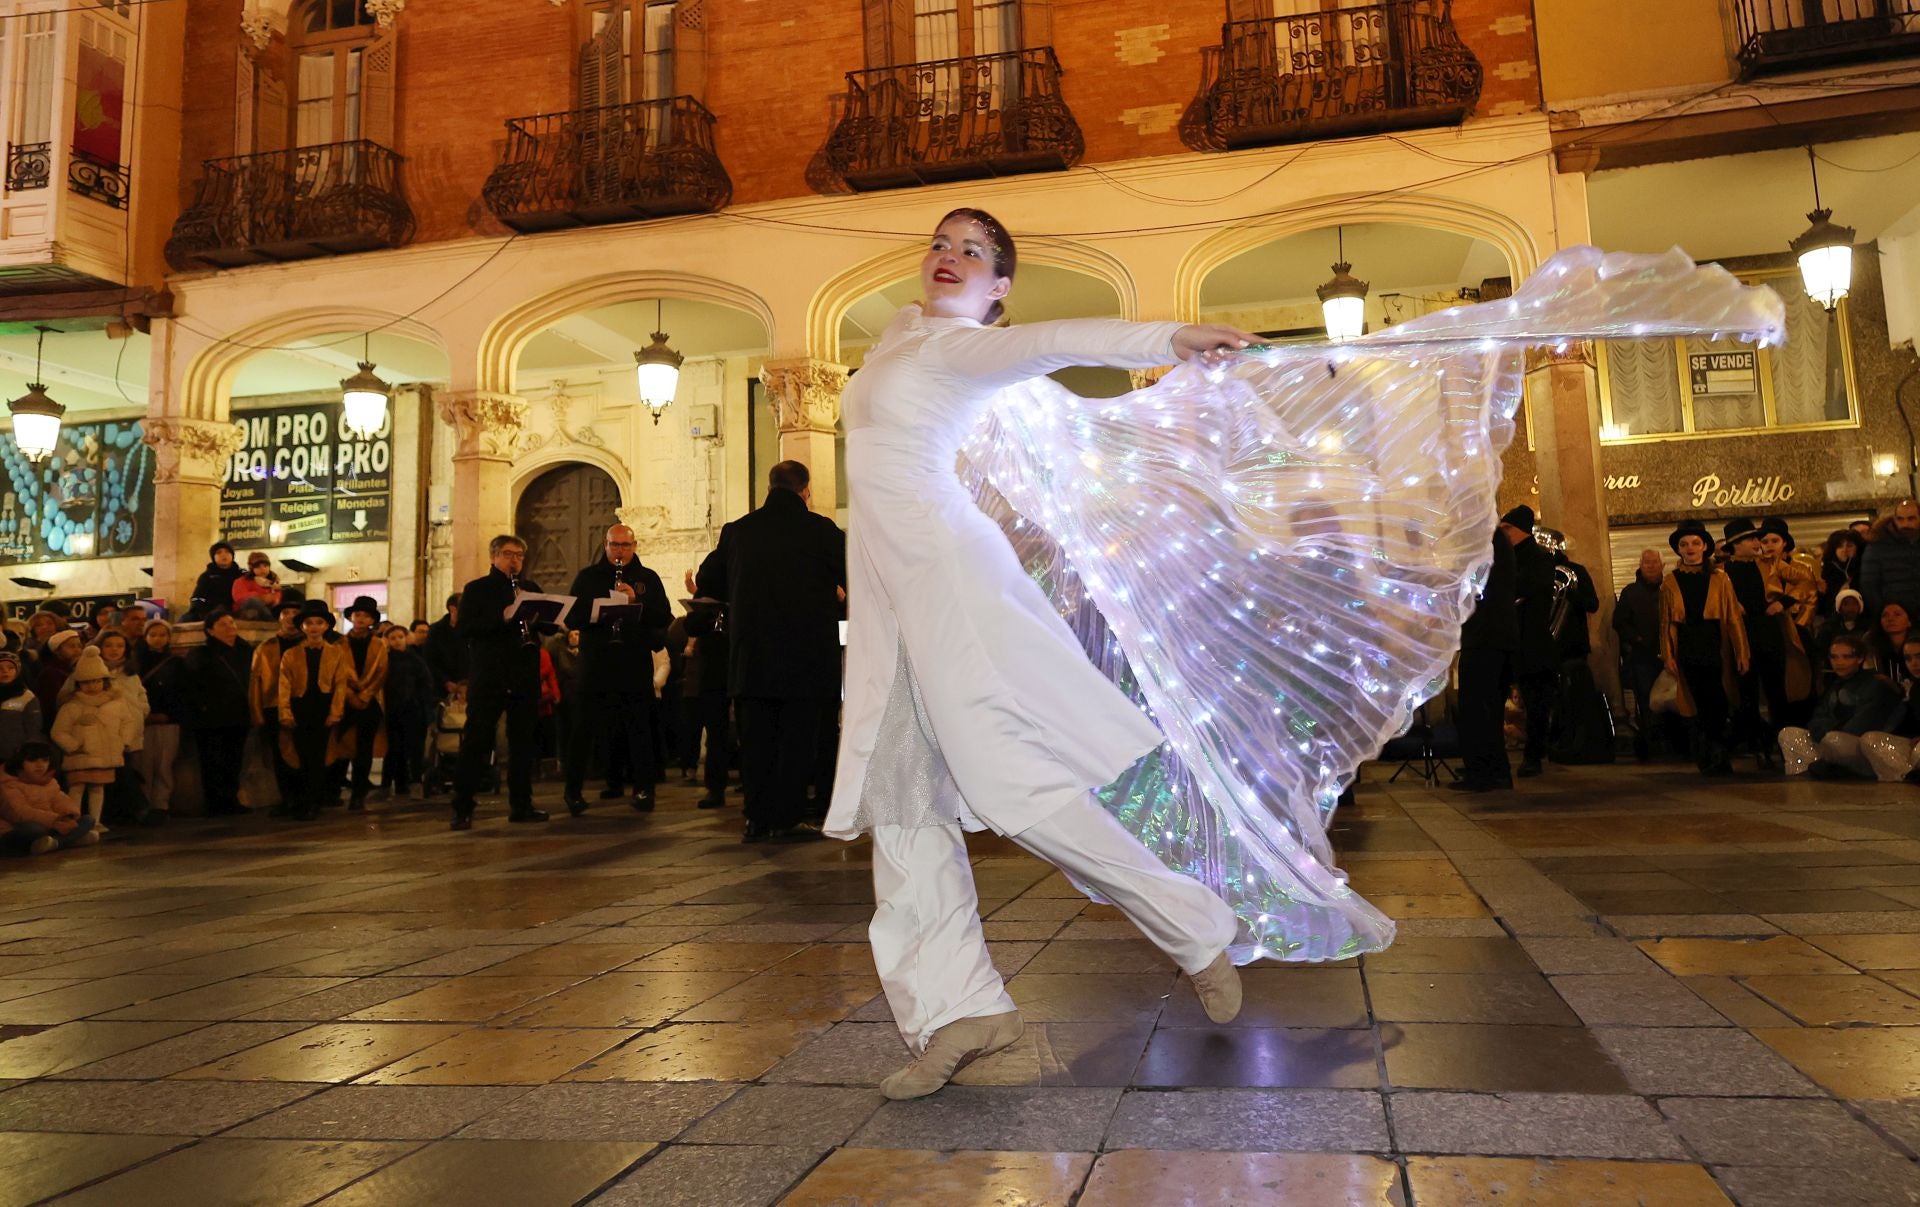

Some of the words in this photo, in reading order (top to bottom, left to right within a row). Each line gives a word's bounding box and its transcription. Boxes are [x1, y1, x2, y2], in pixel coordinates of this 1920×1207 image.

[1691, 356, 1707, 370] SE
[1711, 354, 1753, 369] VENDE
[234, 416, 270, 449] OM
[274, 446, 330, 480] COM
[337, 440, 389, 476] PRO
[223, 487, 255, 500] Joyas
[1692, 472, 1795, 507] Portillo
[280, 502, 320, 515] Relojes
[336, 498, 386, 510] Monedas
[220, 507, 264, 518] apeletas
